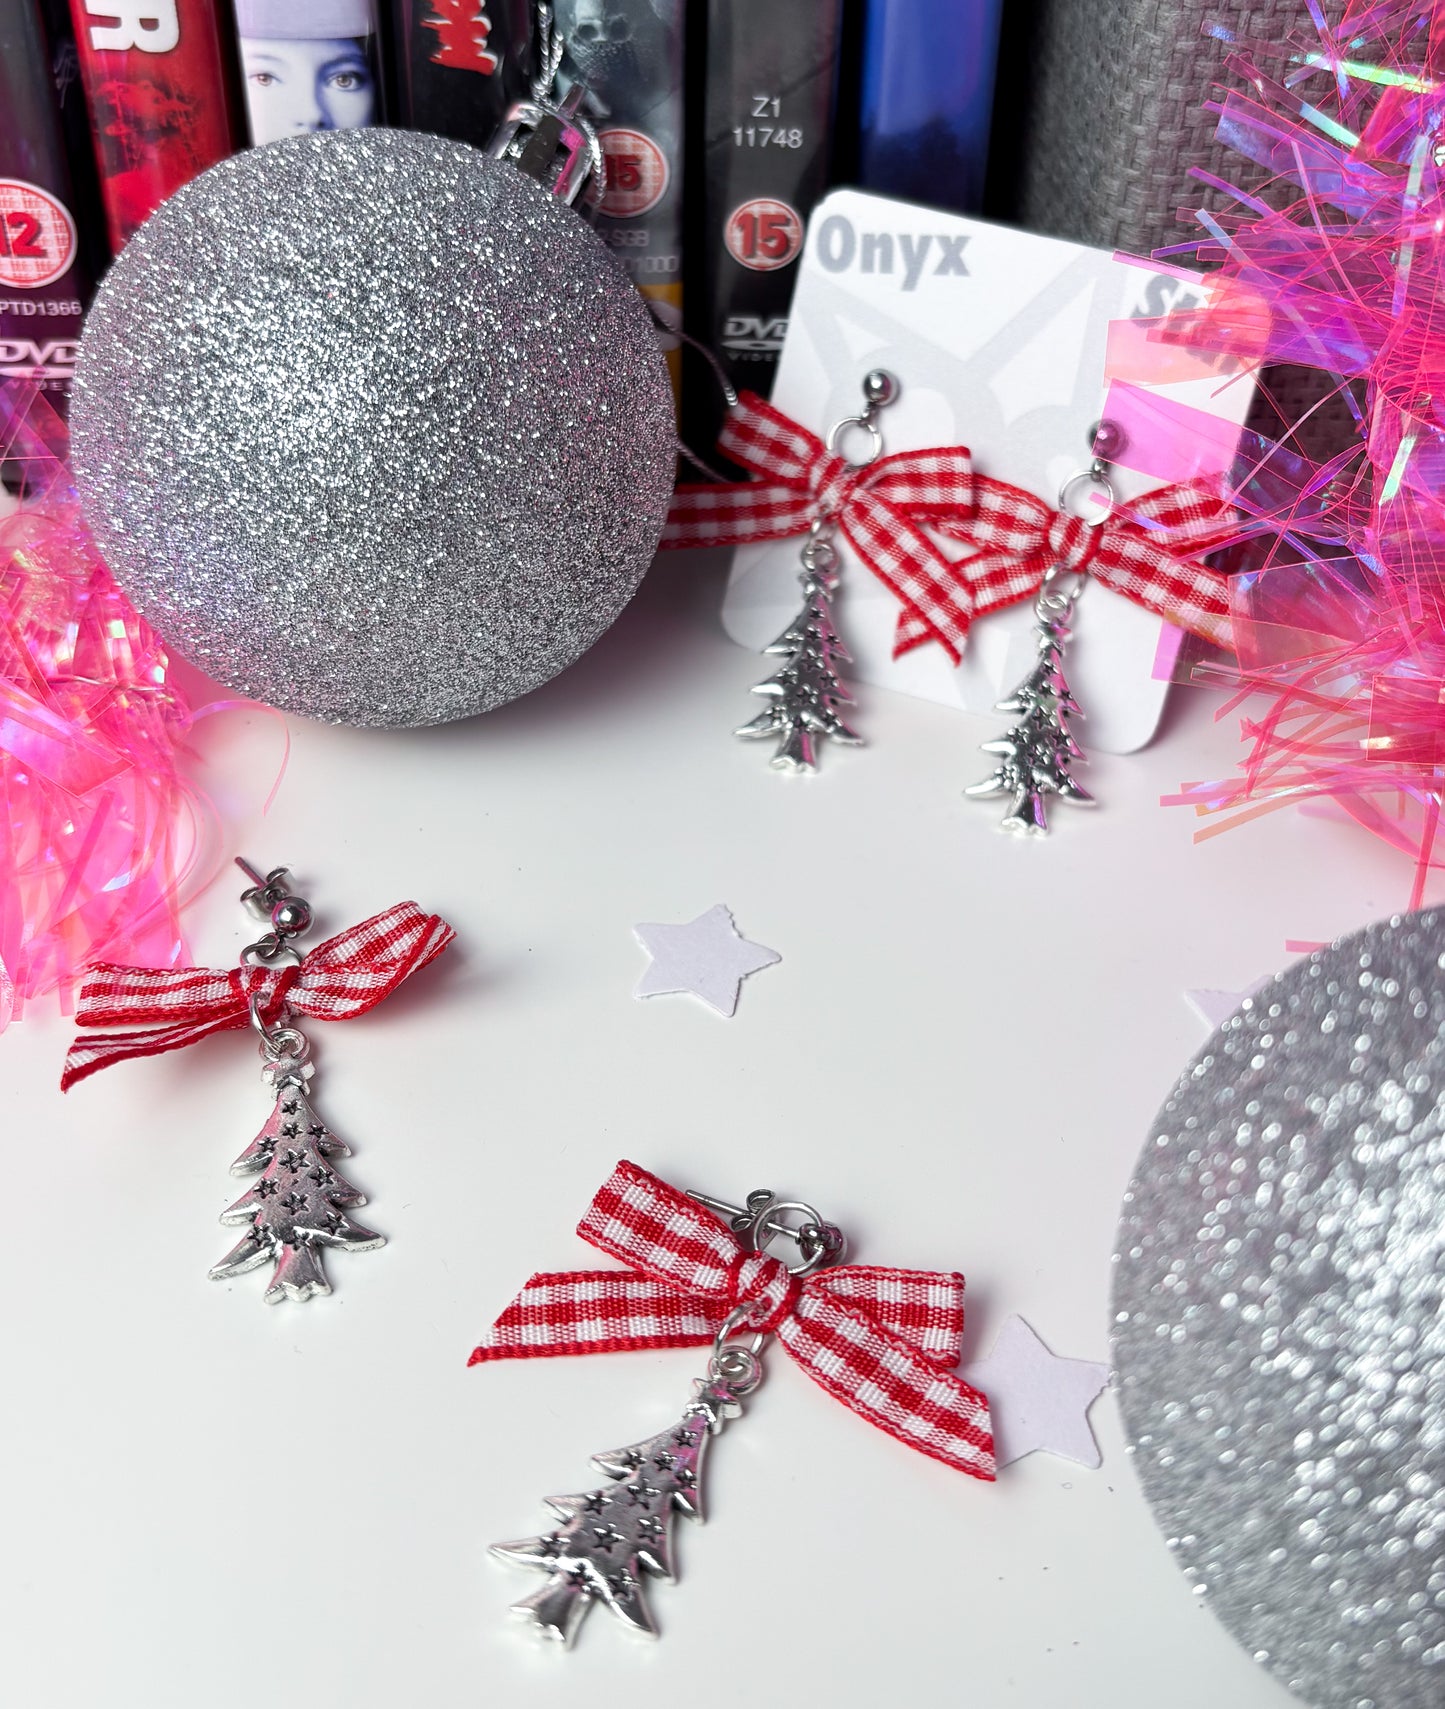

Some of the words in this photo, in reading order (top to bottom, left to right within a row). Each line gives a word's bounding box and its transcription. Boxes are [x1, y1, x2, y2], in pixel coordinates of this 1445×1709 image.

[752, 96, 782, 119] Z1
[733, 126, 804, 149] 11748
[735, 212, 793, 260] 15
[815, 213, 972, 292] Onyx
